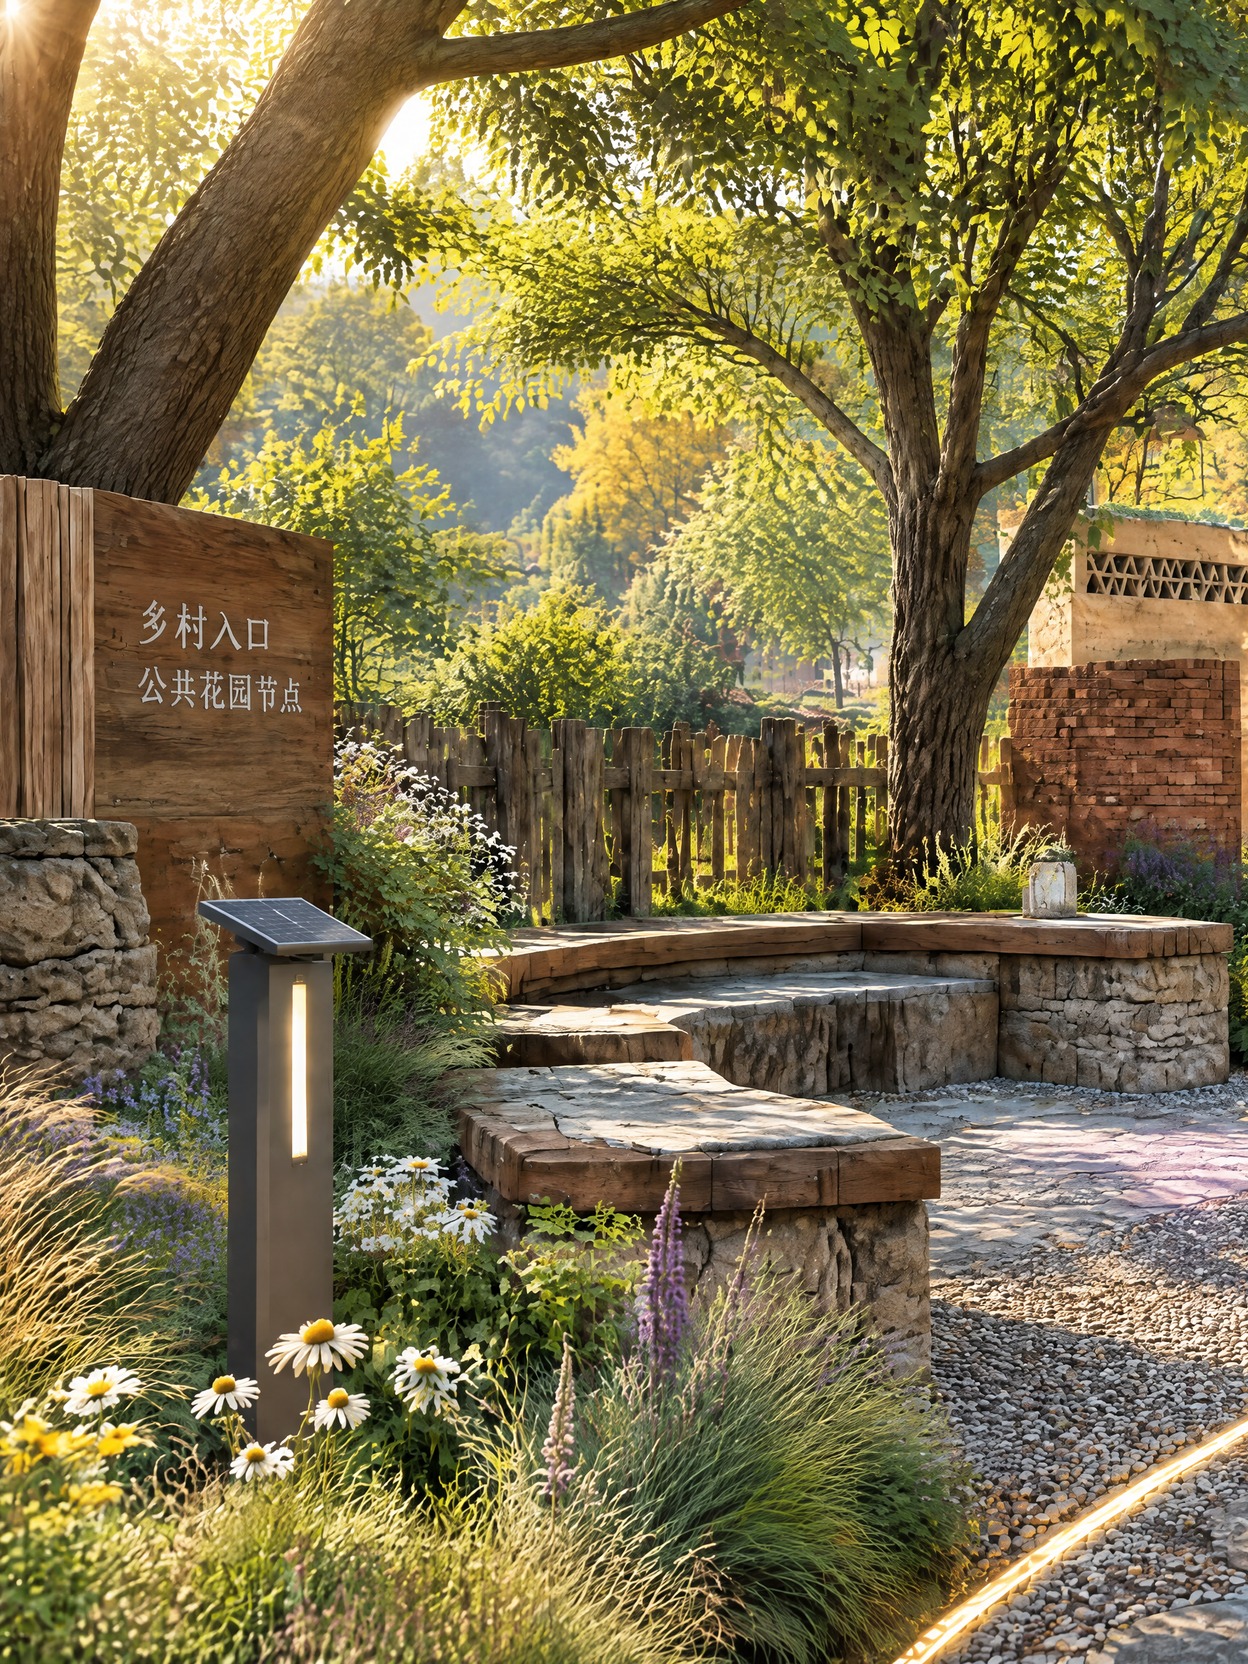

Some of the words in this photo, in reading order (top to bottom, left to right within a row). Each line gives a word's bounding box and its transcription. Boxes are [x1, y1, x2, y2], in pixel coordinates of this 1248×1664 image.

[139, 599, 269, 651] 乡村入口
[138, 666, 303, 713] 公共花园节点
